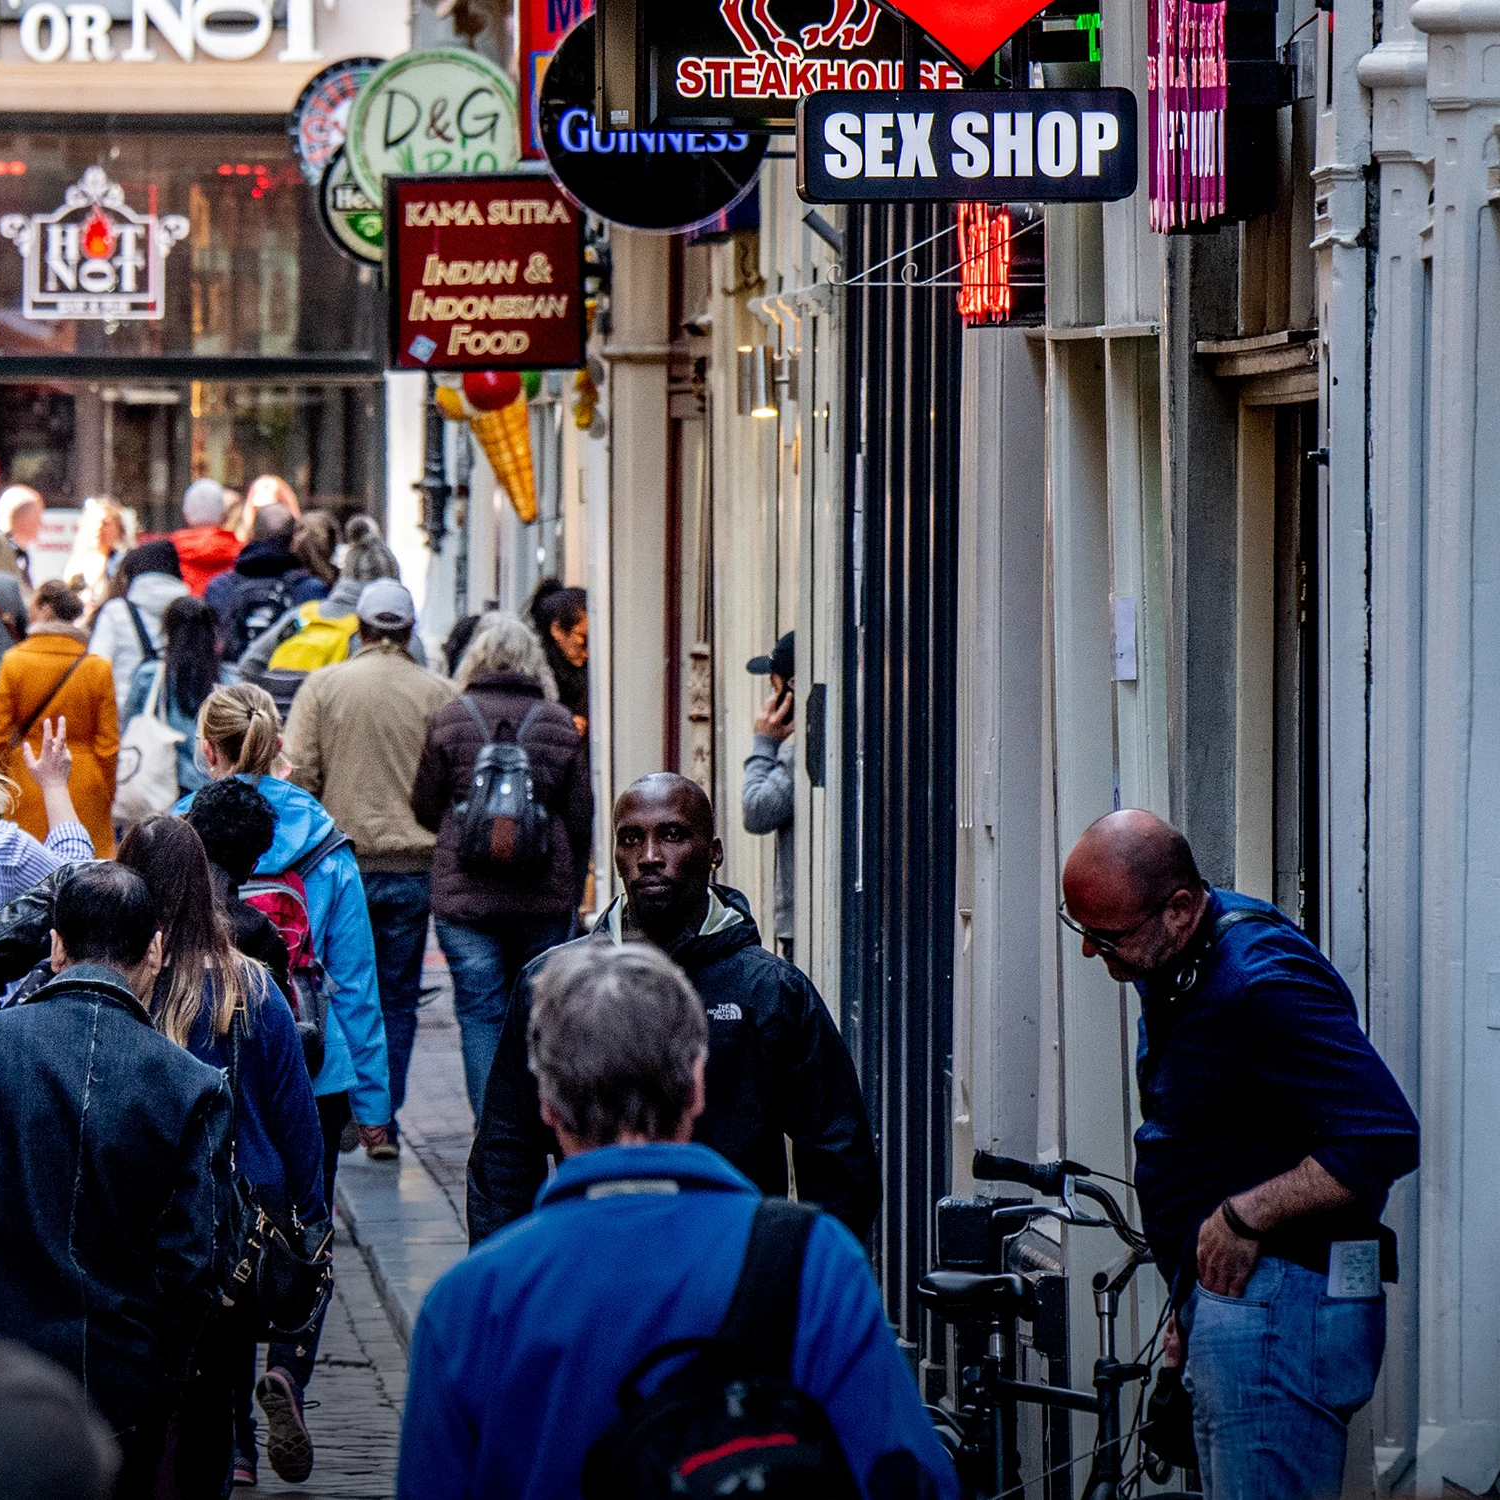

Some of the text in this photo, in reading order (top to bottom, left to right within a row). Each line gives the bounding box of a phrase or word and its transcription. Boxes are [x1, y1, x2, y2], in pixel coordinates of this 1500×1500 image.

[19, 3, 117, 63] OR
[122, 0, 336, 63] NOT
[384, 88, 499, 151] D&G
[558, 107, 749, 153] GUINNESS
[823, 111, 1120, 180] SEX SHOP
[404, 199, 572, 227] KAMA SUTRA
[421, 251, 554, 286] INDIAN &
[407, 289, 569, 321] INDONESIAN
[446, 323, 531, 356] FOOD
